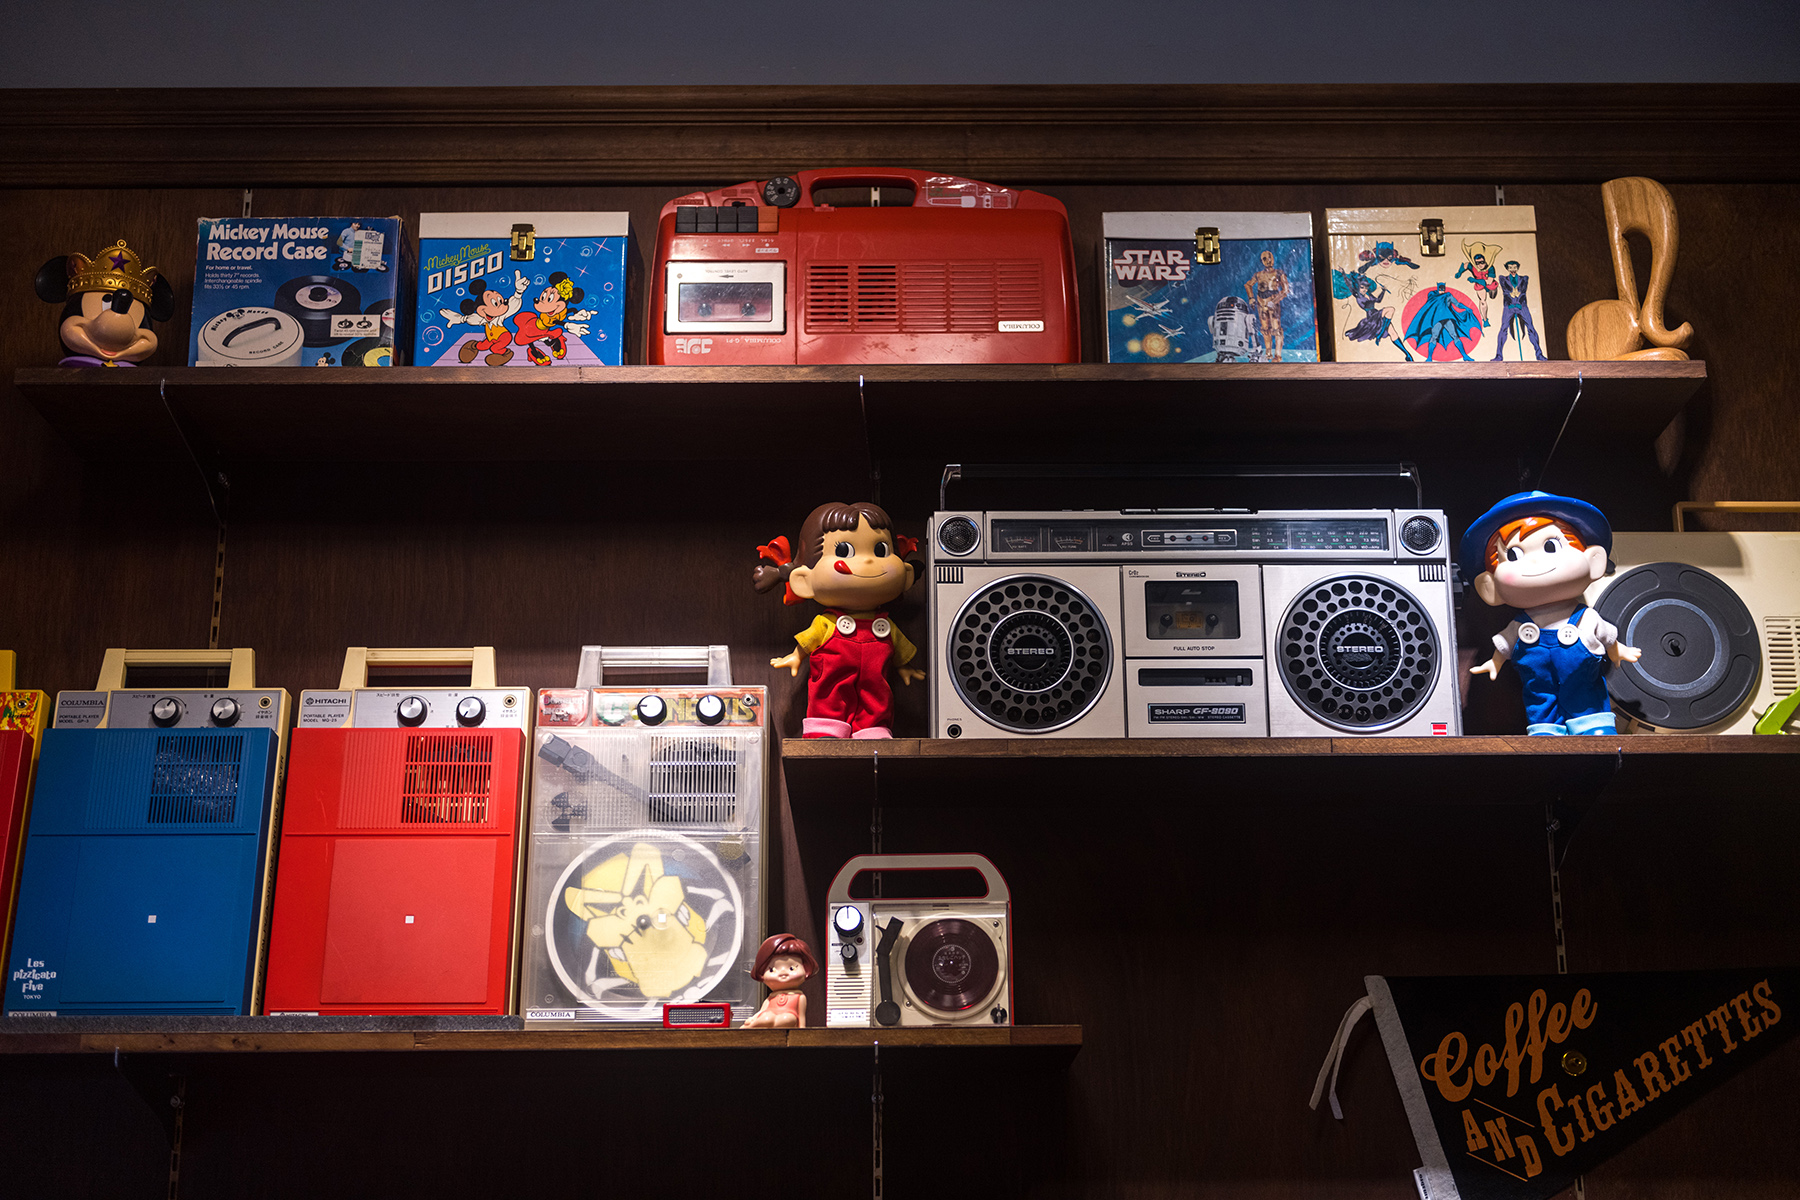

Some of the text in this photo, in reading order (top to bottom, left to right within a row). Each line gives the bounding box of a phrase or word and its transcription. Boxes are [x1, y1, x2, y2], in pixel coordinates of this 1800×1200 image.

[208, 224, 329, 243] Mickey Mouse
[206, 242, 328, 261] Record Case
[424, 244, 491, 271] Mickey Mouse
[1113, 250, 1190, 265] STAR
[427, 251, 504, 294] DISCO
[1114, 265, 1191, 280] WARS
[1192, 707, 1239, 715] GF-9090
[27, 958, 45, 968] Les
[13, 969, 57, 981] pizzicato
[22, 979, 44, 993] Five
[1420, 988, 1598, 1102] Coffee
[1536, 978, 1783, 1157] CIGARETTES
[1462, 1108, 1543, 1178] AND
